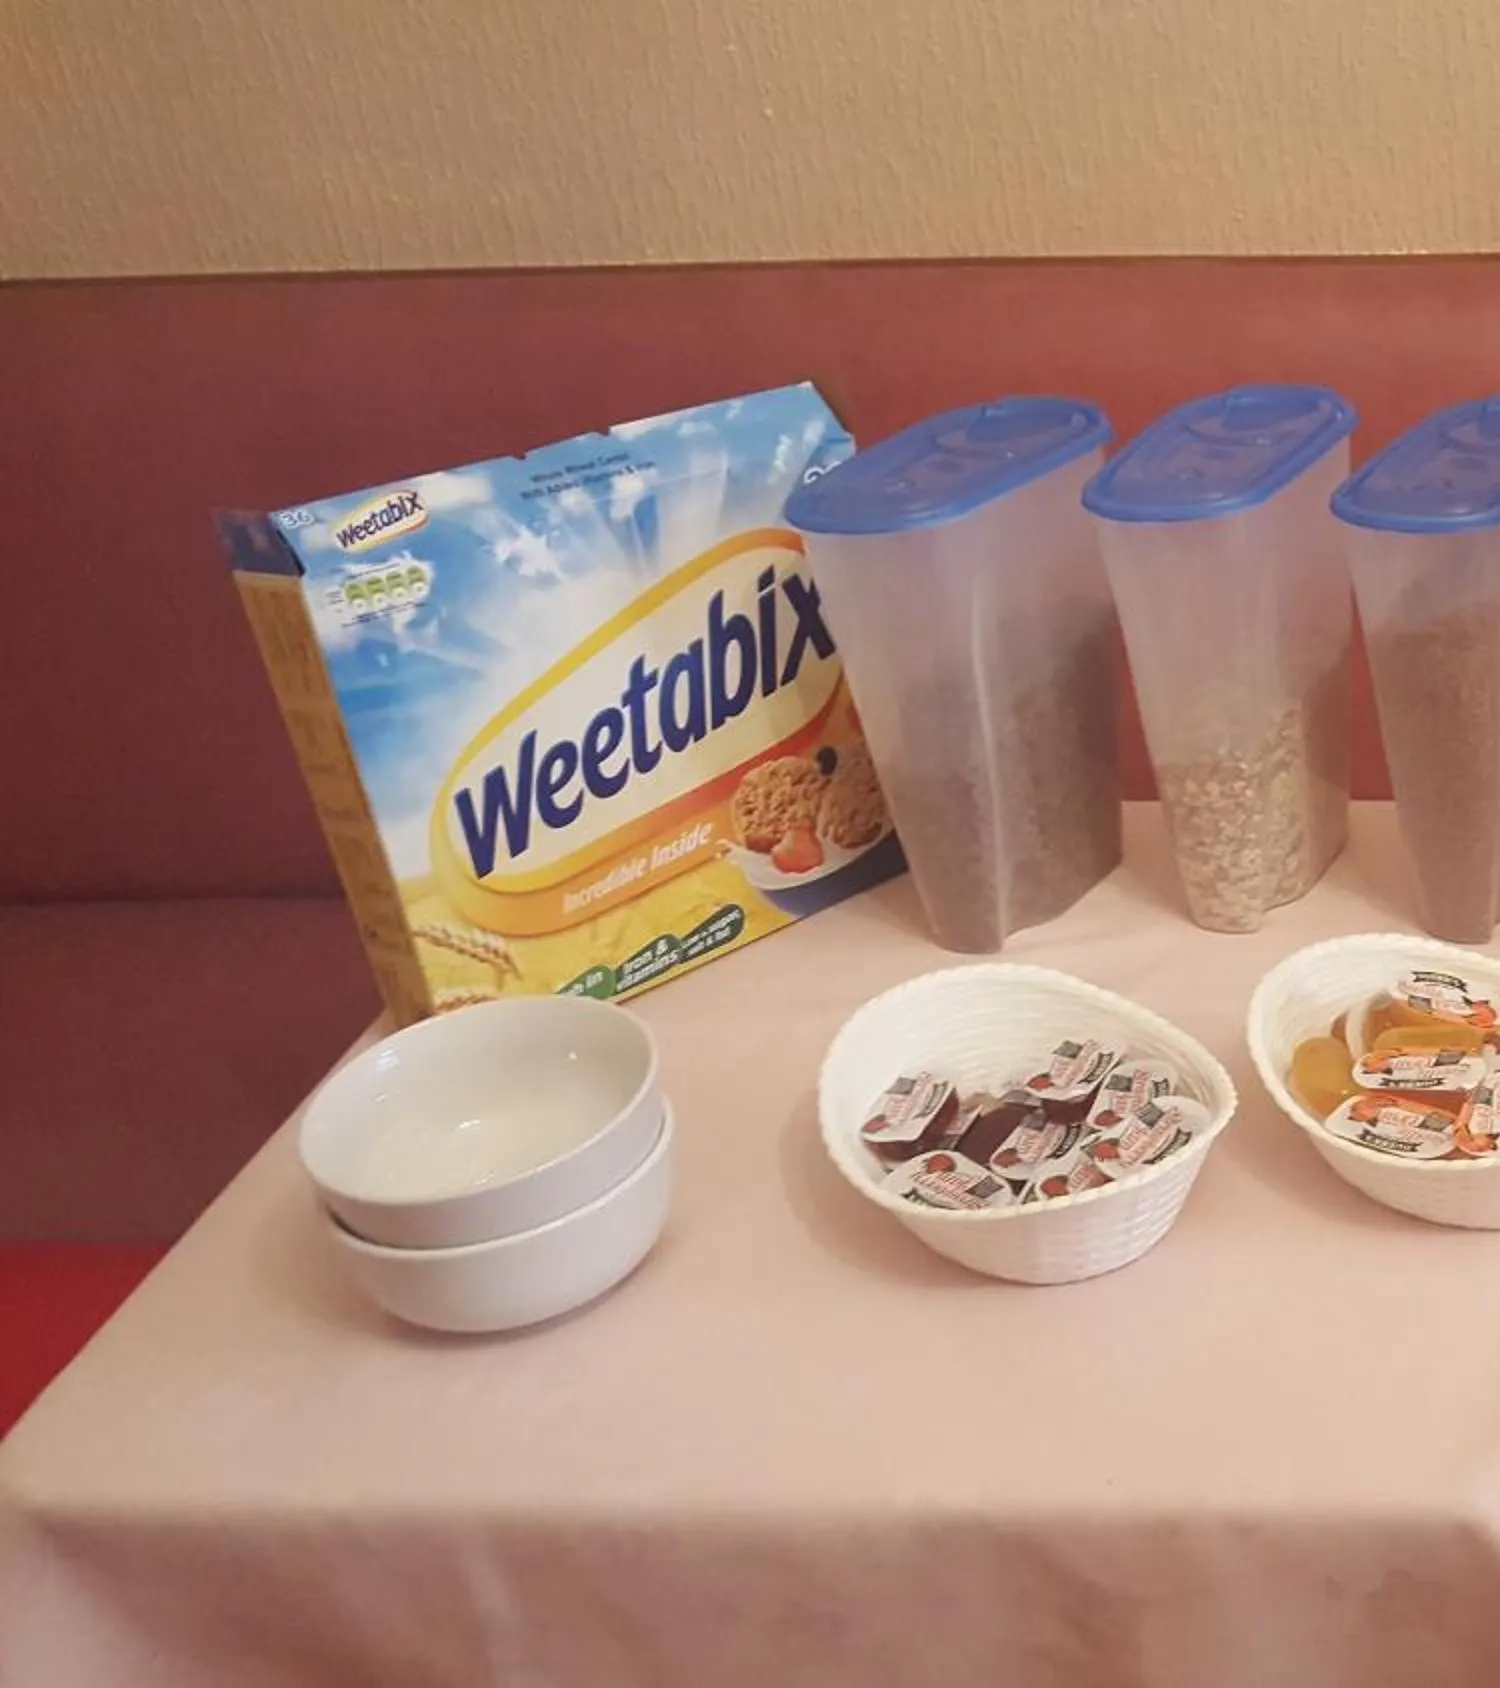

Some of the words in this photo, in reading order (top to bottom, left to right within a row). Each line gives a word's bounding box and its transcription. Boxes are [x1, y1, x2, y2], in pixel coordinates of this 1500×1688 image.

[335, 491, 425, 548] Weetabix
[453, 563, 837, 880] Weetabix
[563, 856, 648, 915] Incredible
[650, 821, 716, 869] Inside
